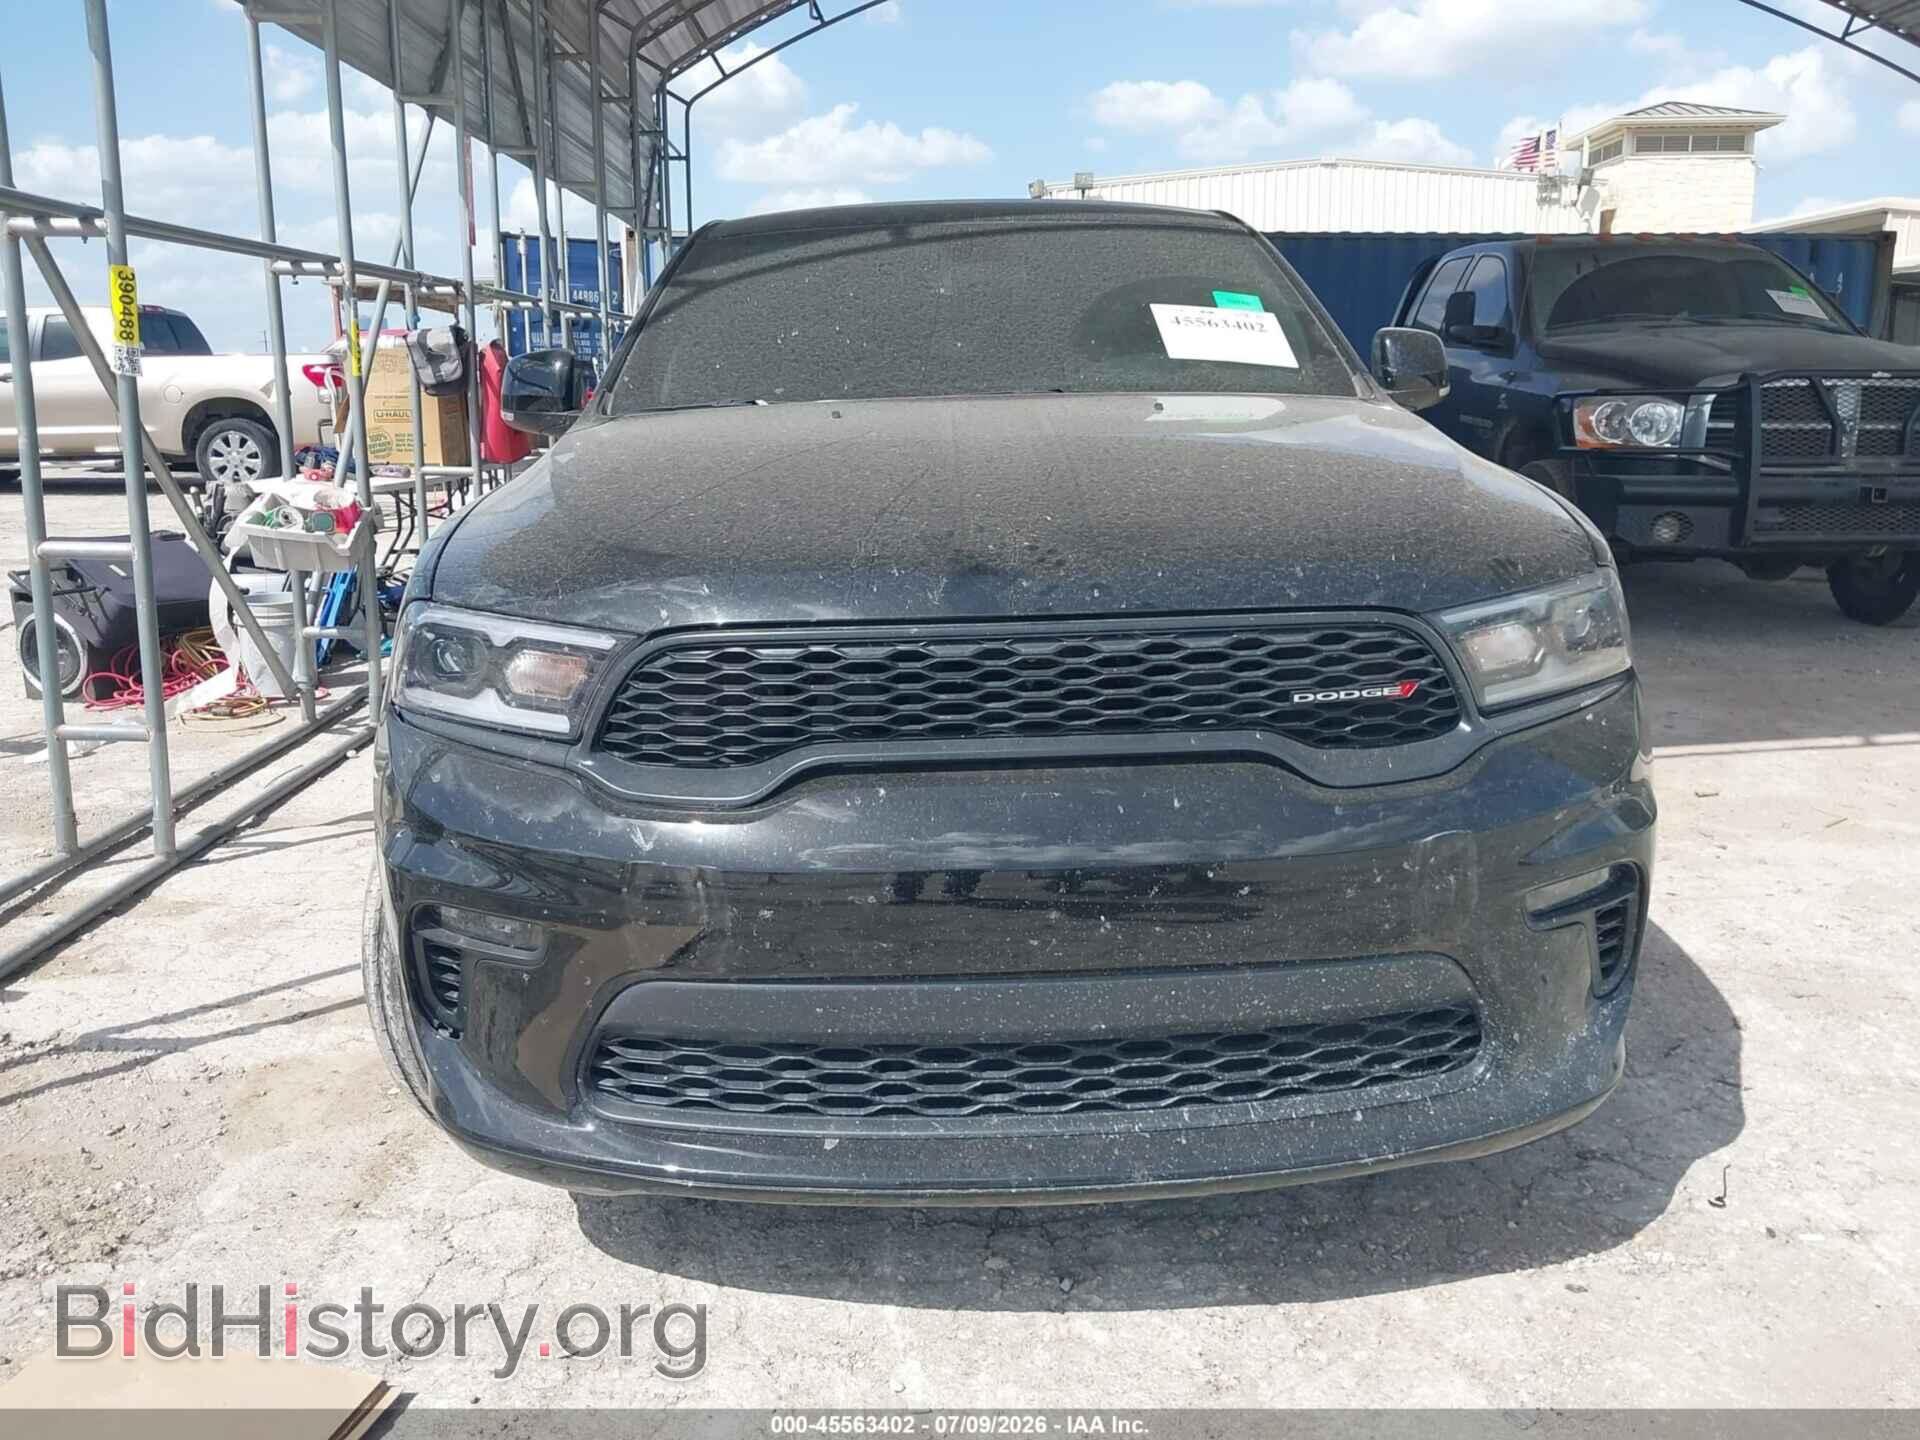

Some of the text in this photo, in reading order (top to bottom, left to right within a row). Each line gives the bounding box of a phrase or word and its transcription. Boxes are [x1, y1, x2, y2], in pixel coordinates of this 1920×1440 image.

[118, 270, 135, 341] 390488
[1170, 315, 1269, 333] 45563402
[1293, 686, 1402, 703] DODGE
